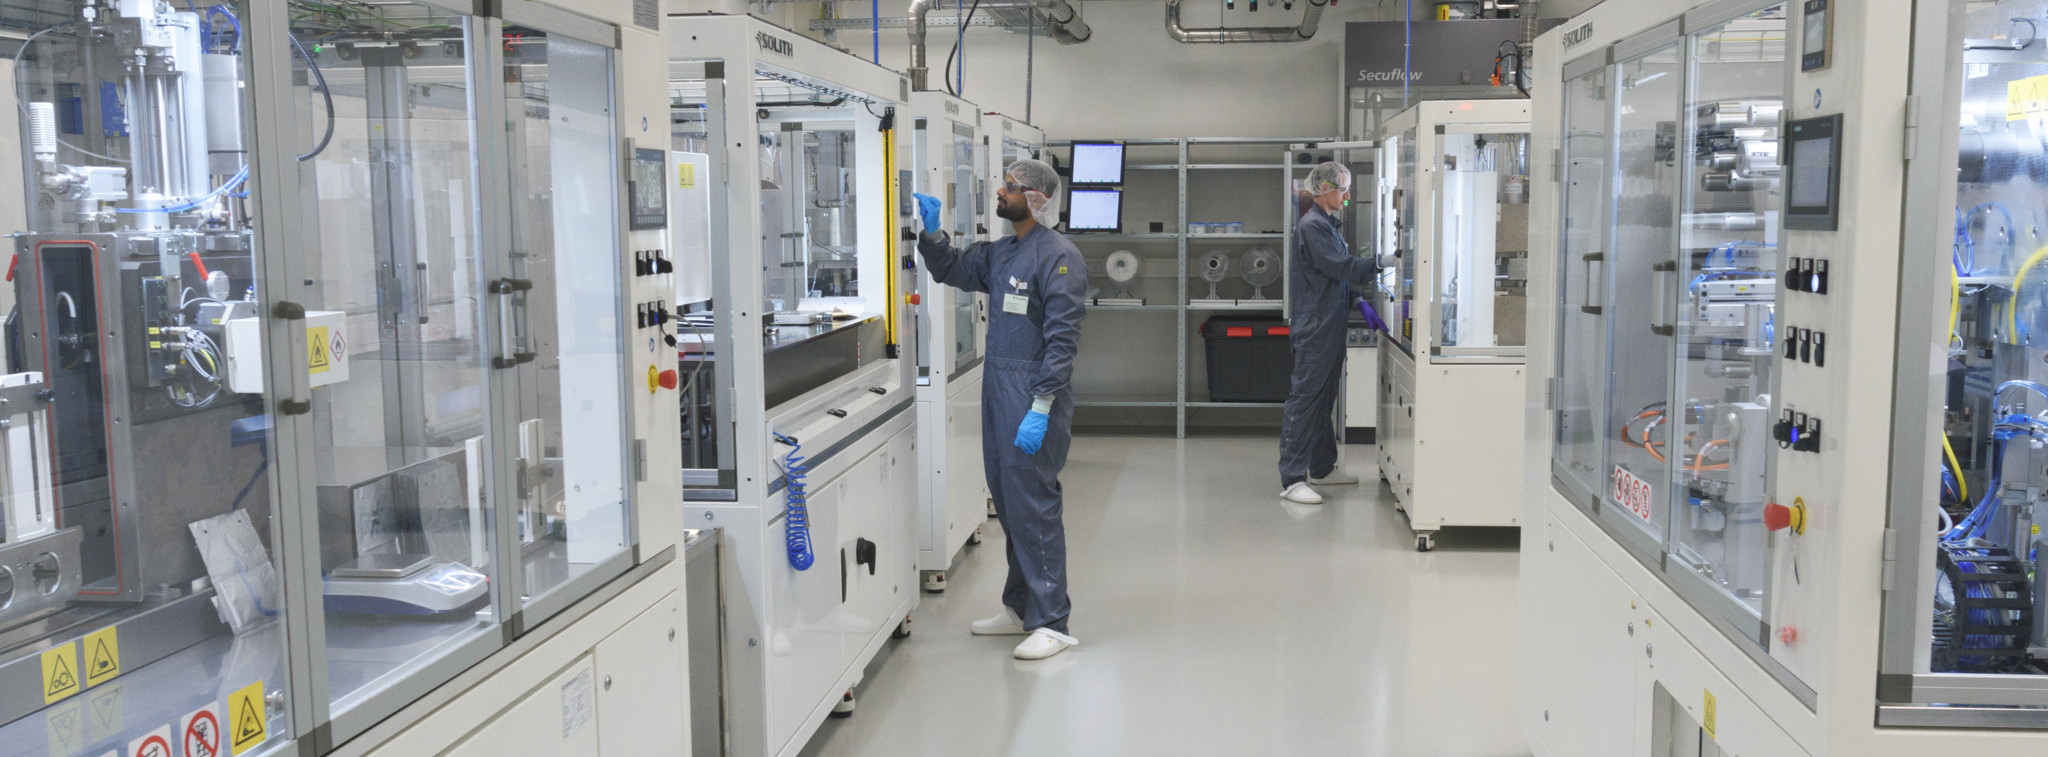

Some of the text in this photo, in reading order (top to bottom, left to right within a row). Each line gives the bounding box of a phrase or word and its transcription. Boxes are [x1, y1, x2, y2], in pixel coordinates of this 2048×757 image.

[761, 32, 794, 58] SOLITH
[1567, 21, 1593, 48] SOLITH
[1358, 68, 1423, 81] Secuflow
